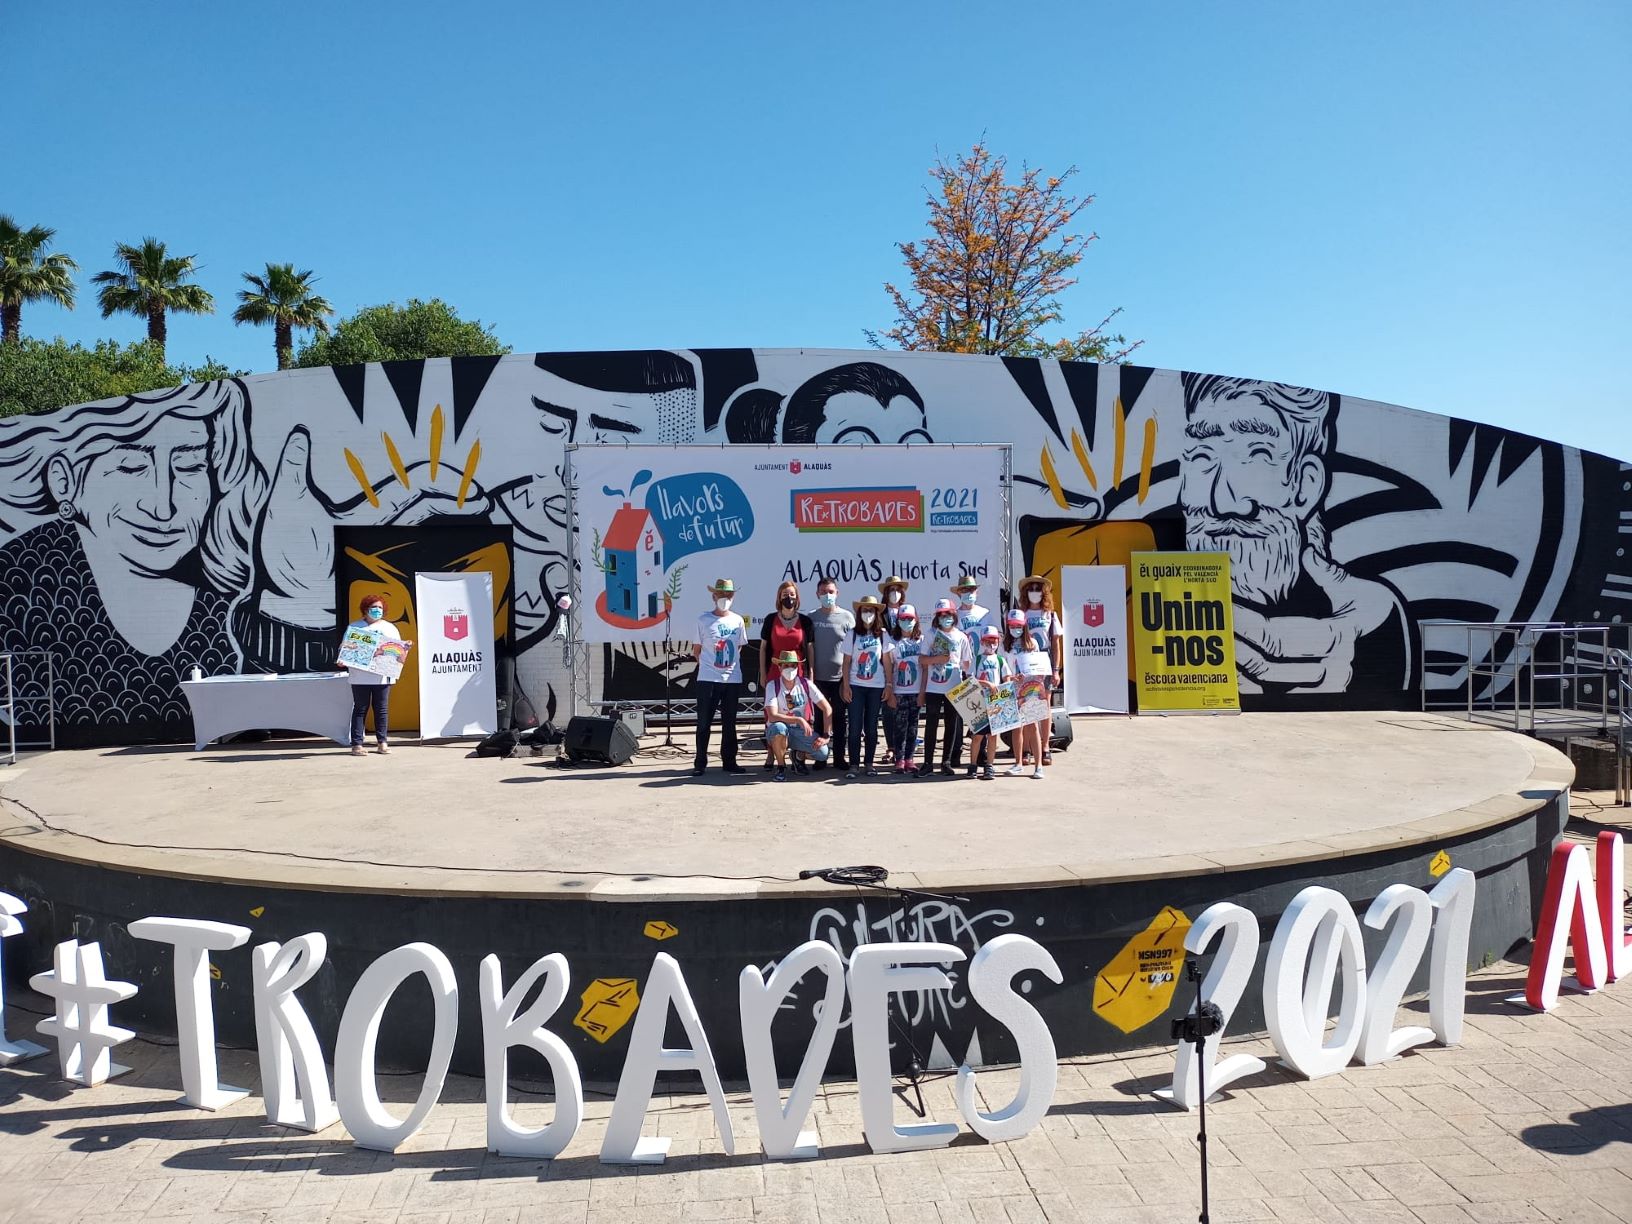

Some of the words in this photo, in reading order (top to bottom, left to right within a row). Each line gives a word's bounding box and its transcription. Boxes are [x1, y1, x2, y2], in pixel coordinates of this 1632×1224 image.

[754, 463, 788, 471] AJUNTAMENT
[657, 483, 724, 520] llavors
[931, 488, 978, 509] 2021
[678, 524, 694, 542] de
[688, 514, 744, 546] futur
[781, 553, 883, 583] ALAQUÀS
[958, 559, 988, 579] Sud
[1152, 563, 1182, 581] guaix
[1141, 592, 1225, 632] Unim
[1073, 636, 1116, 648] ALAQUÀS
[1152, 635, 1225, 667] -nos
[432, 650, 482, 664] ALAQUÀS
[1073, 649, 1116, 657] AJUNTAMENT
[432, 664, 482, 674] AJUNTAMENT
[1177, 673, 1228, 684] valenciana
[1162, 866, 1476, 1112] 2021
